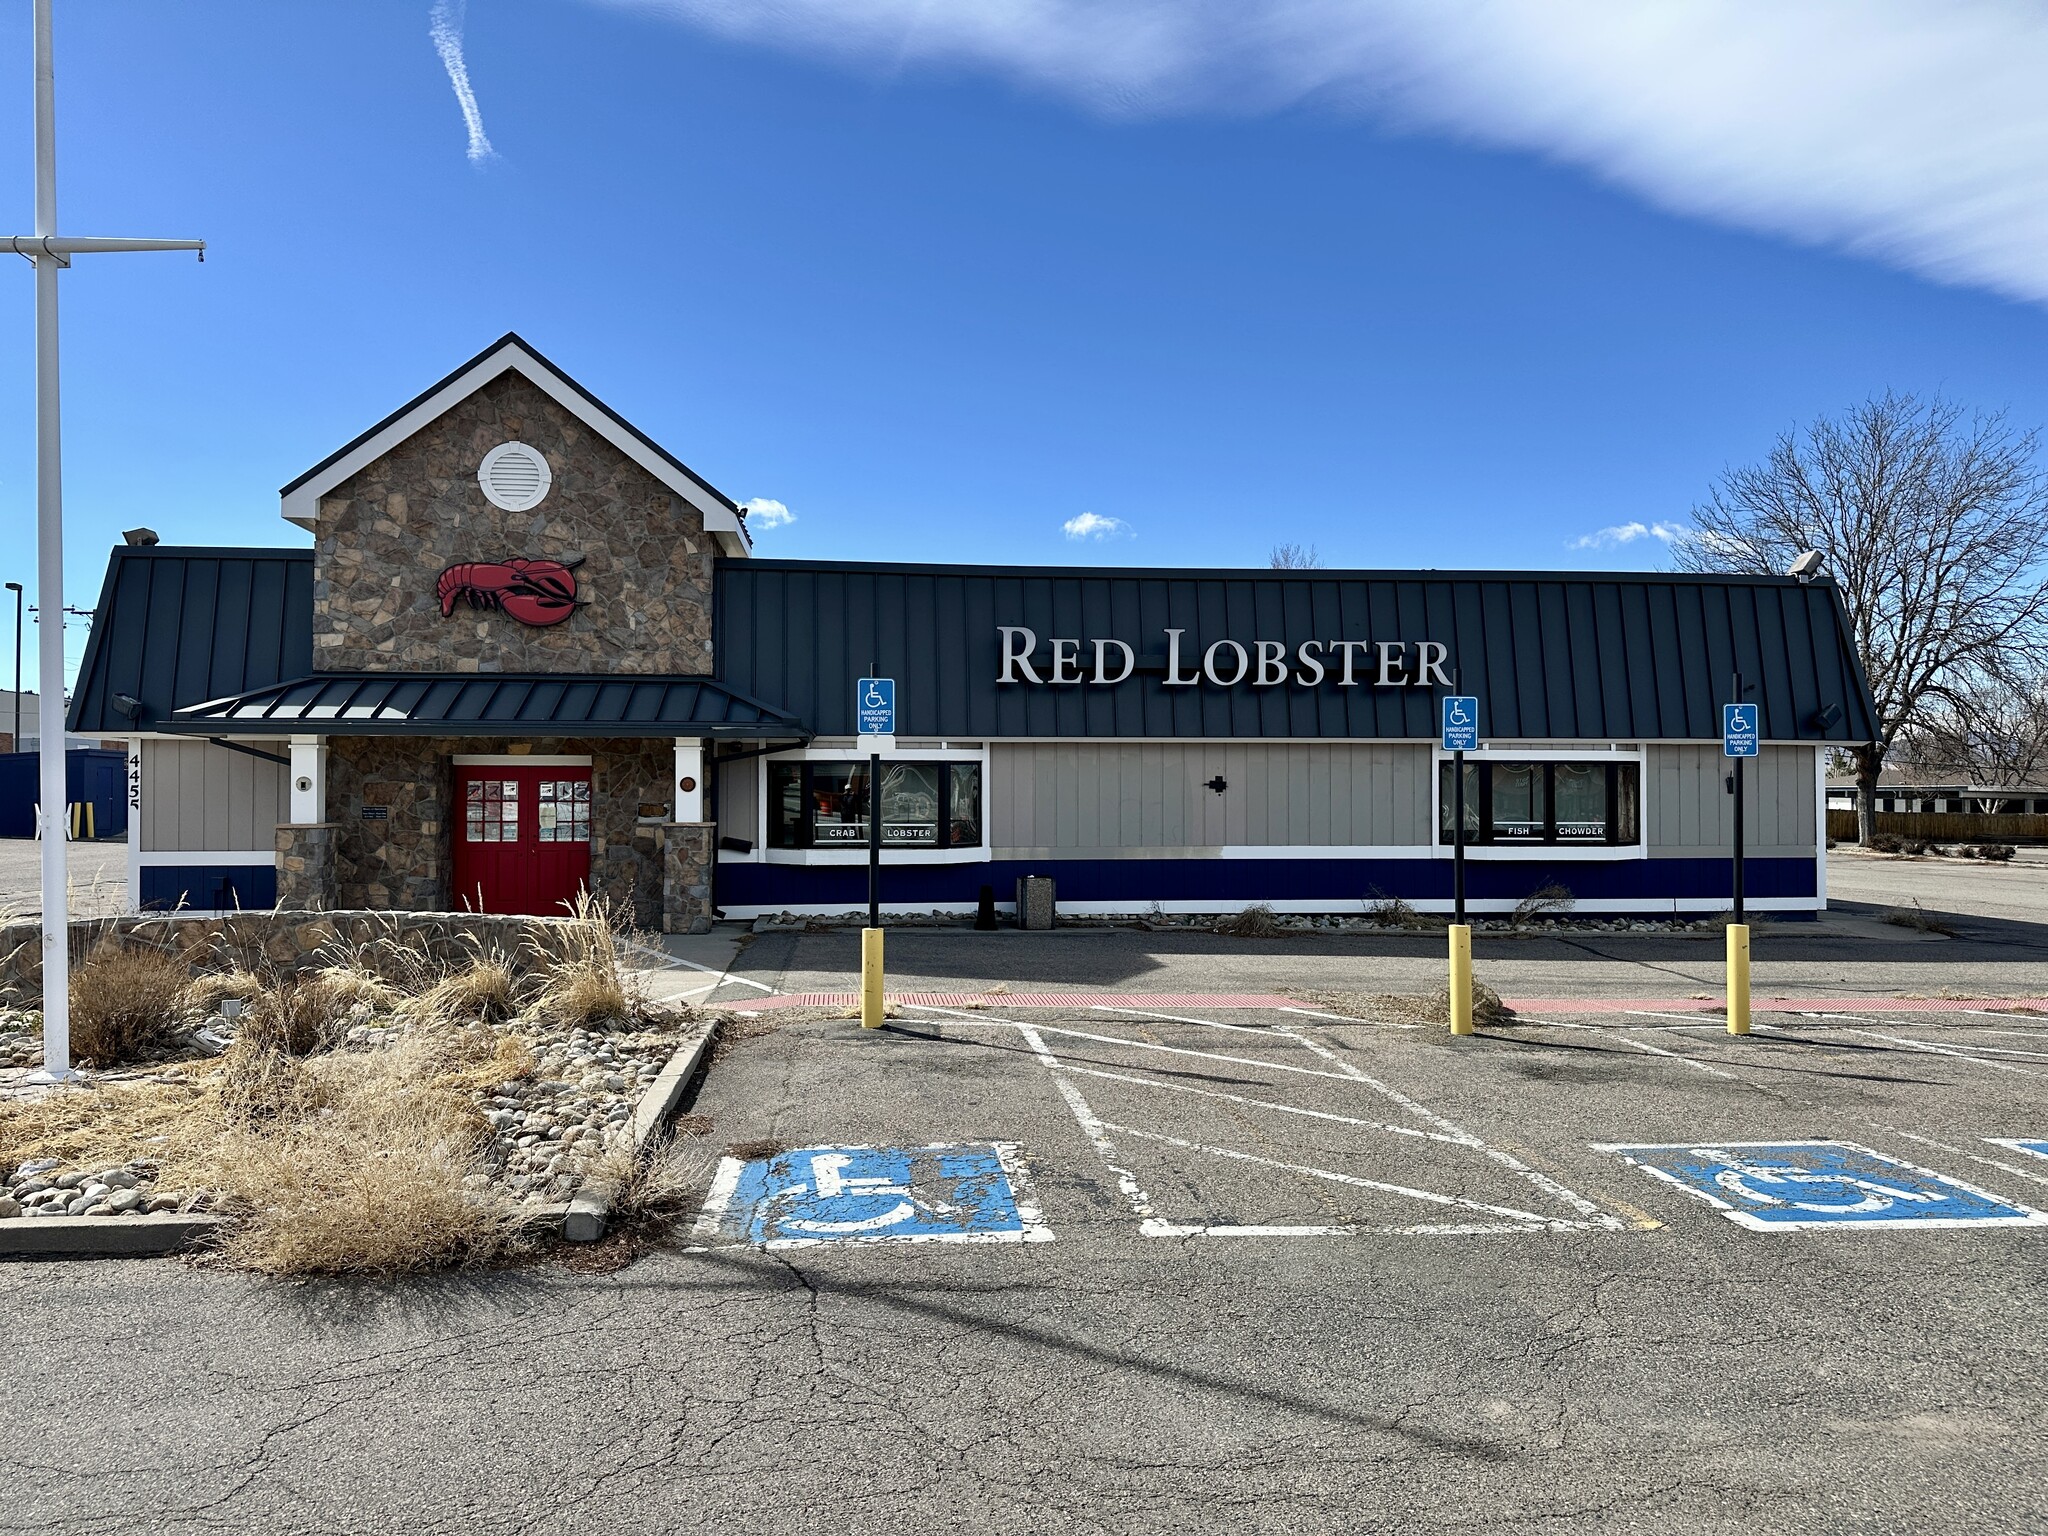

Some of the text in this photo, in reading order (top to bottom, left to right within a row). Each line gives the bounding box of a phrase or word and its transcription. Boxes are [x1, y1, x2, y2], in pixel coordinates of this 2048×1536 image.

[829, 829, 856, 837] CRAB
[887, 829, 931, 837] LOBSTER
[1508, 827, 1529, 835] FISH
[1558, 827, 1604, 835] CHOWDER
